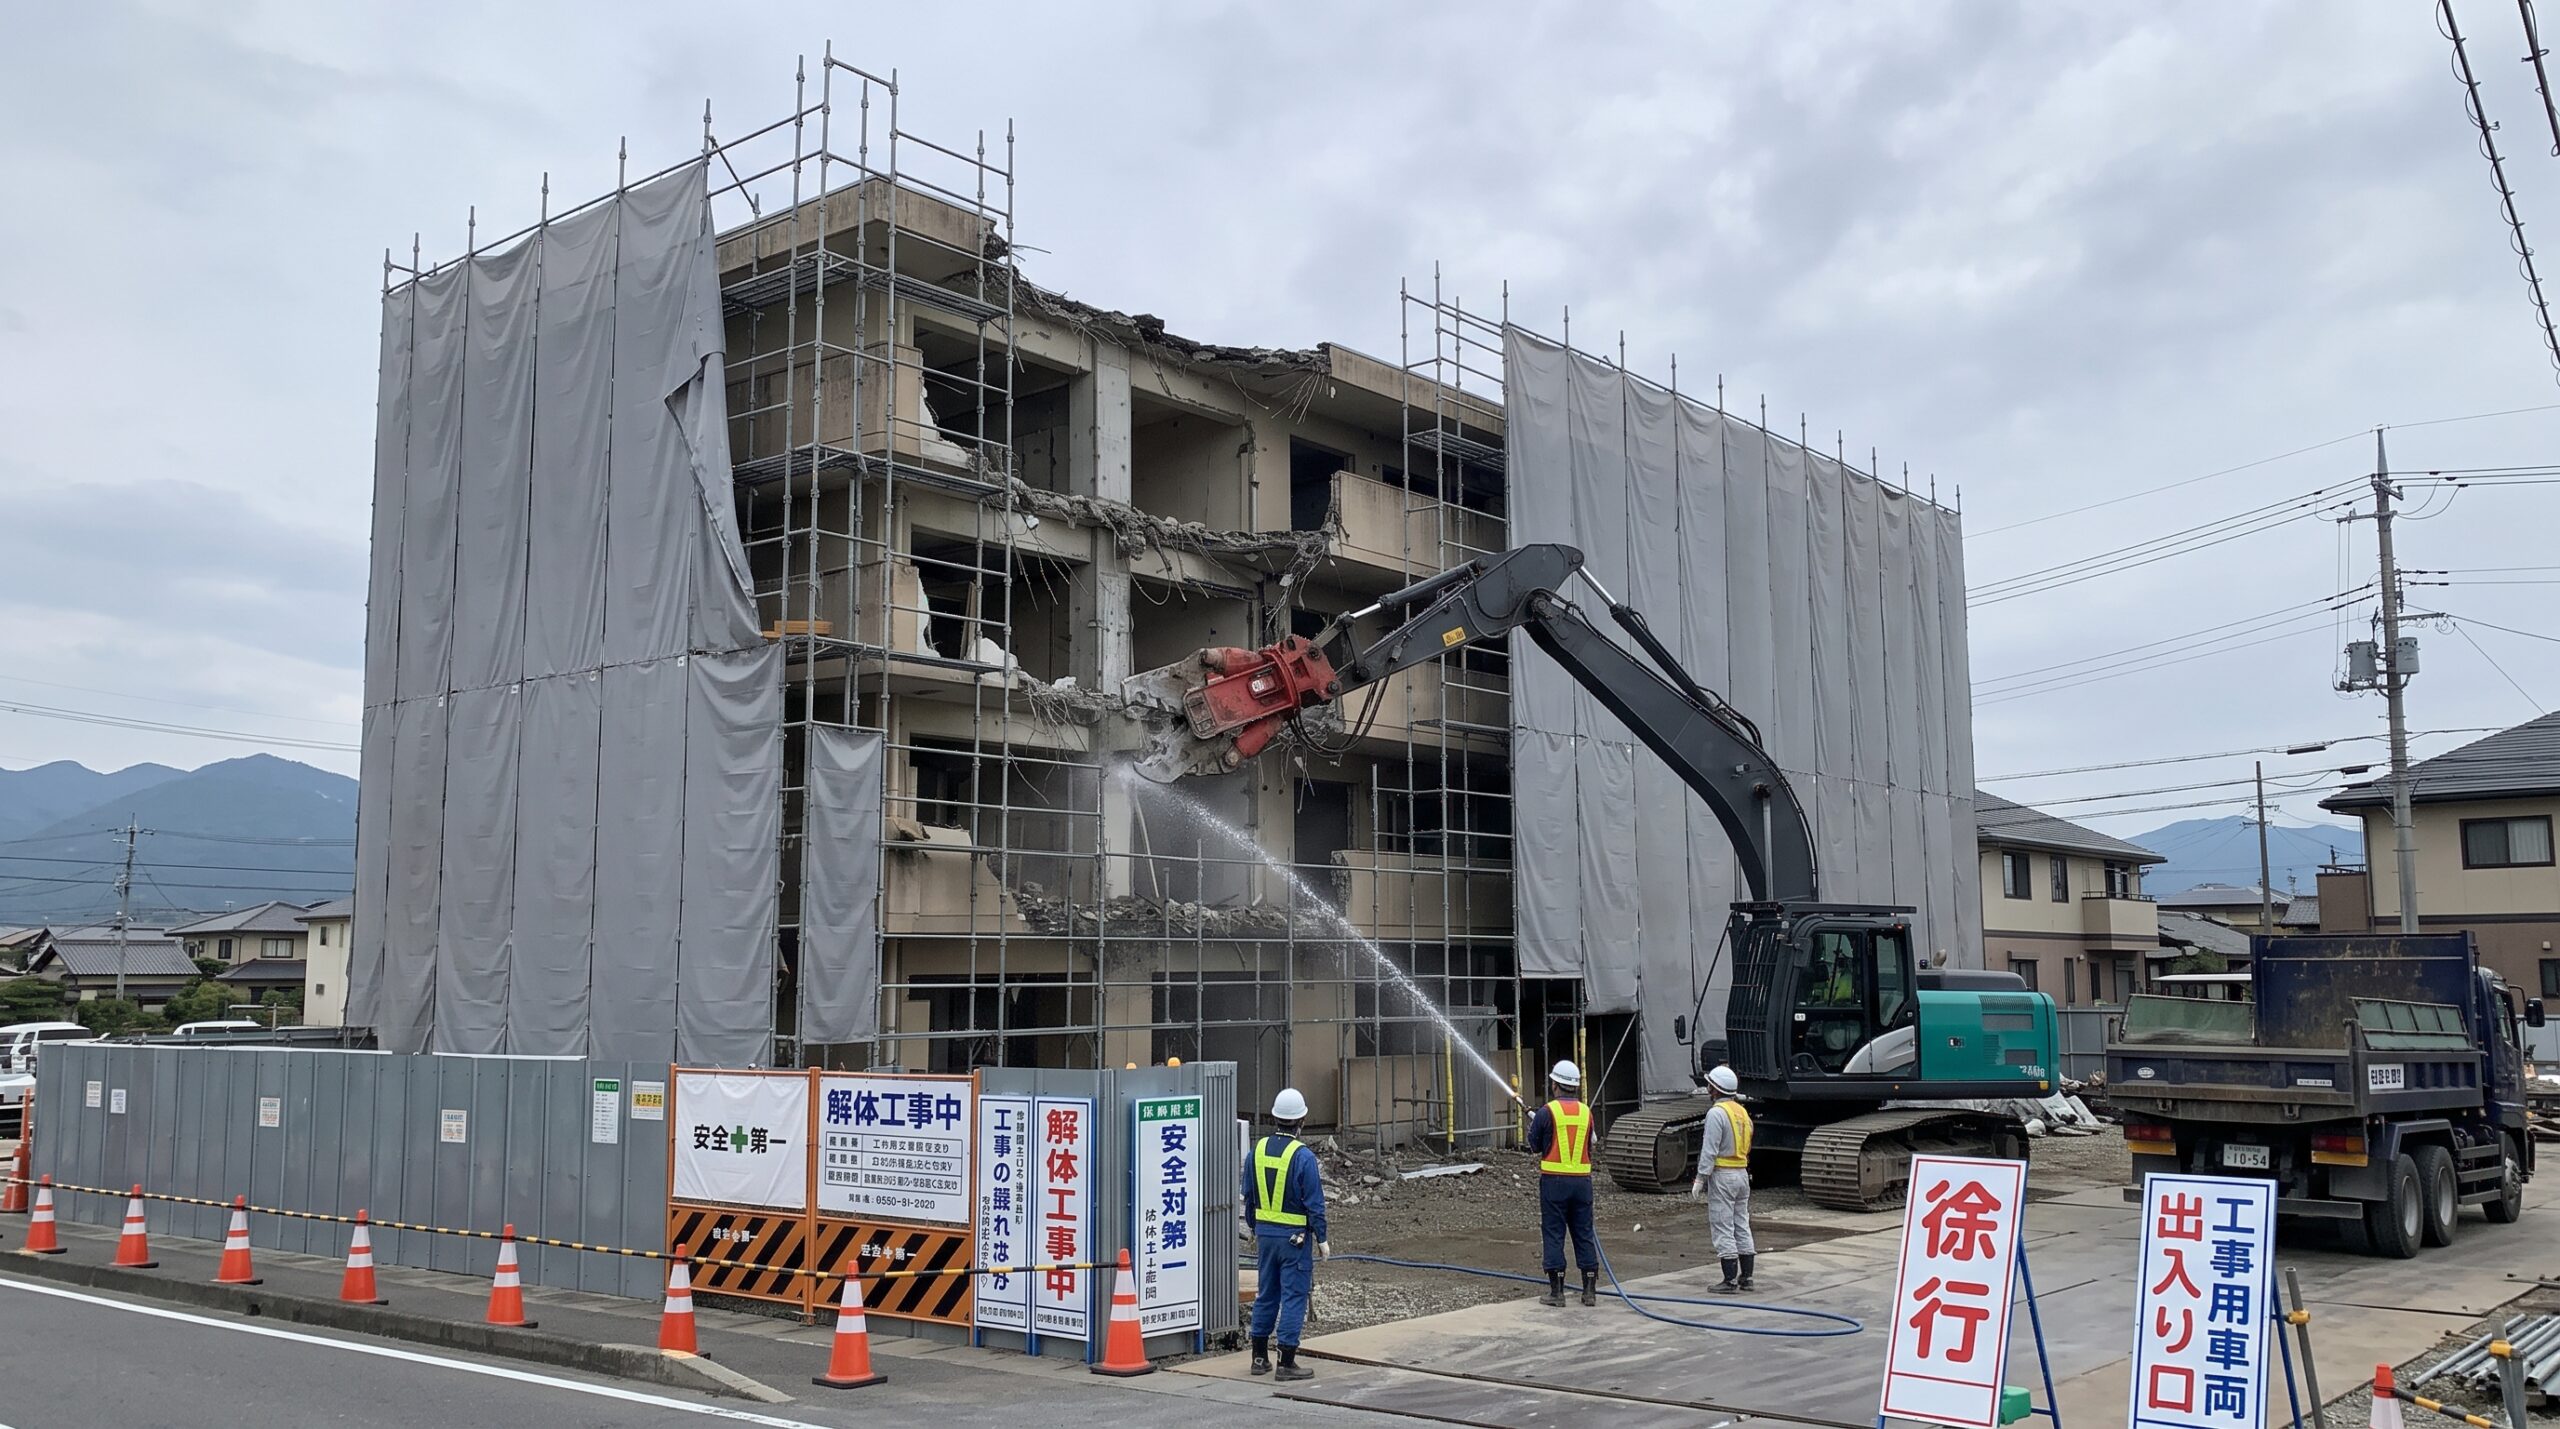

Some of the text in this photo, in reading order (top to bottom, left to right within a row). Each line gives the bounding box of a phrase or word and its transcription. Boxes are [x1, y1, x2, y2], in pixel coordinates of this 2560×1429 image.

[827, 1089, 962, 1131] 解体工事中
[1045, 1108, 1079, 1301] 解体工事中
[1909, 1179, 2002, 1363] 徐行
[2148, 1192, 2204, 1414] 出入り口
[2203, 1197, 2256, 1420] 工事用車両
